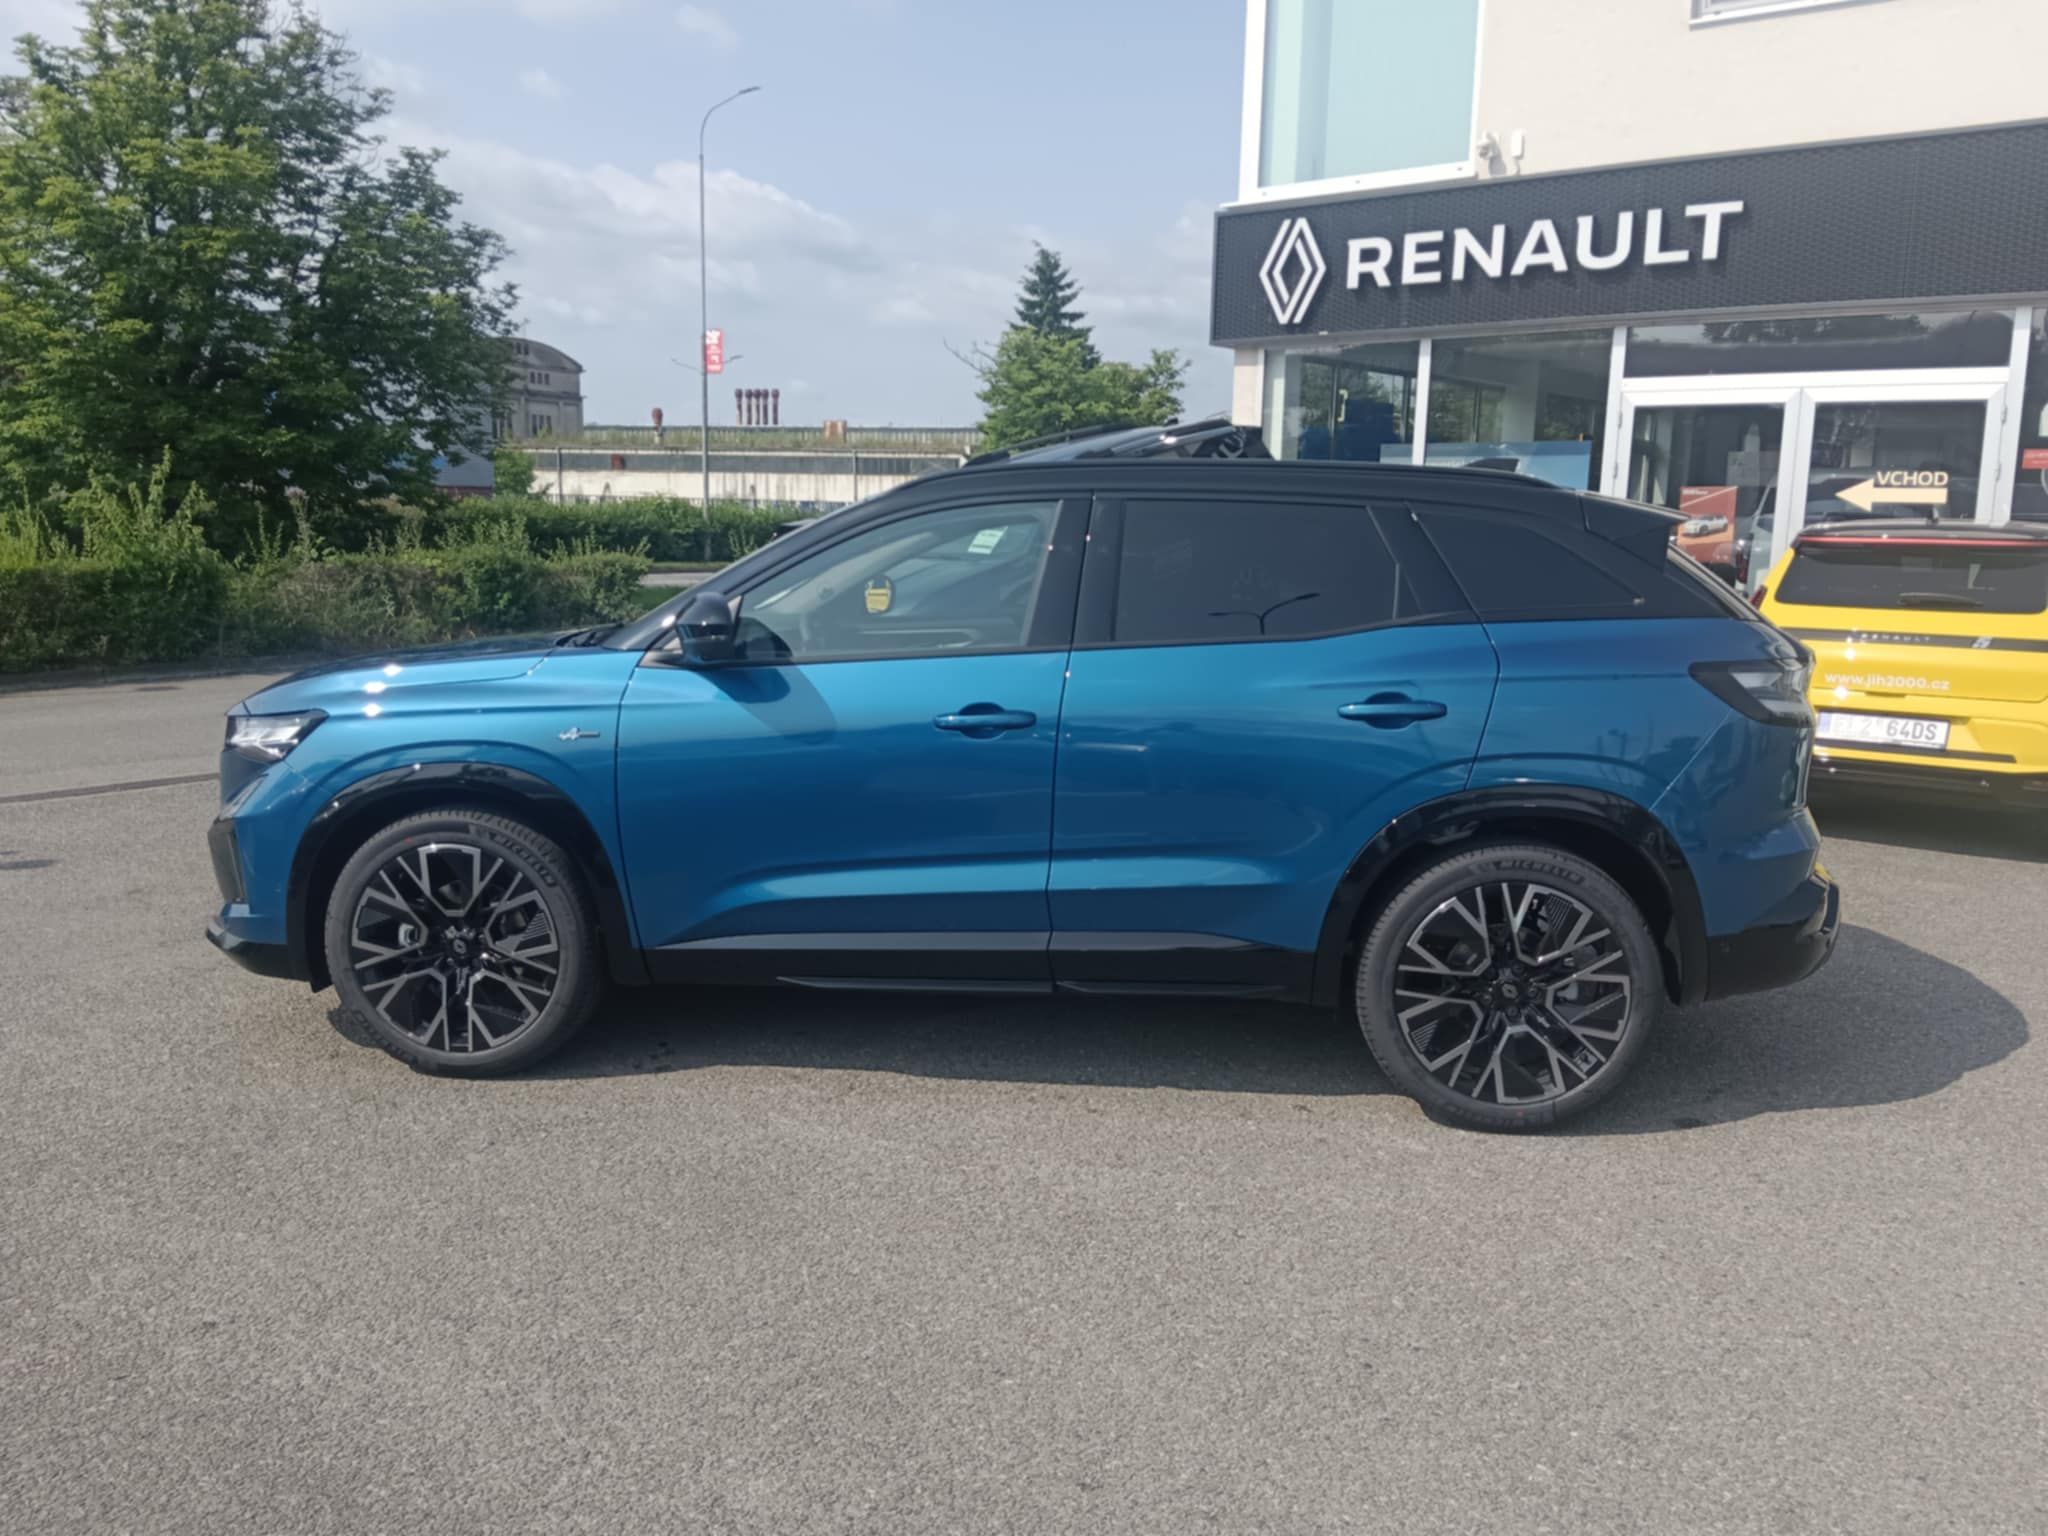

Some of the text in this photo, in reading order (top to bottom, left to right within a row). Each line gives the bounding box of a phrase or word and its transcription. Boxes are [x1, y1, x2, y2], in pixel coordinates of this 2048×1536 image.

[1345, 200, 1745, 291] RENAULT
[1876, 470, 1949, 487] VCHOD
[1824, 672, 1950, 691] www.jih2000.cz
